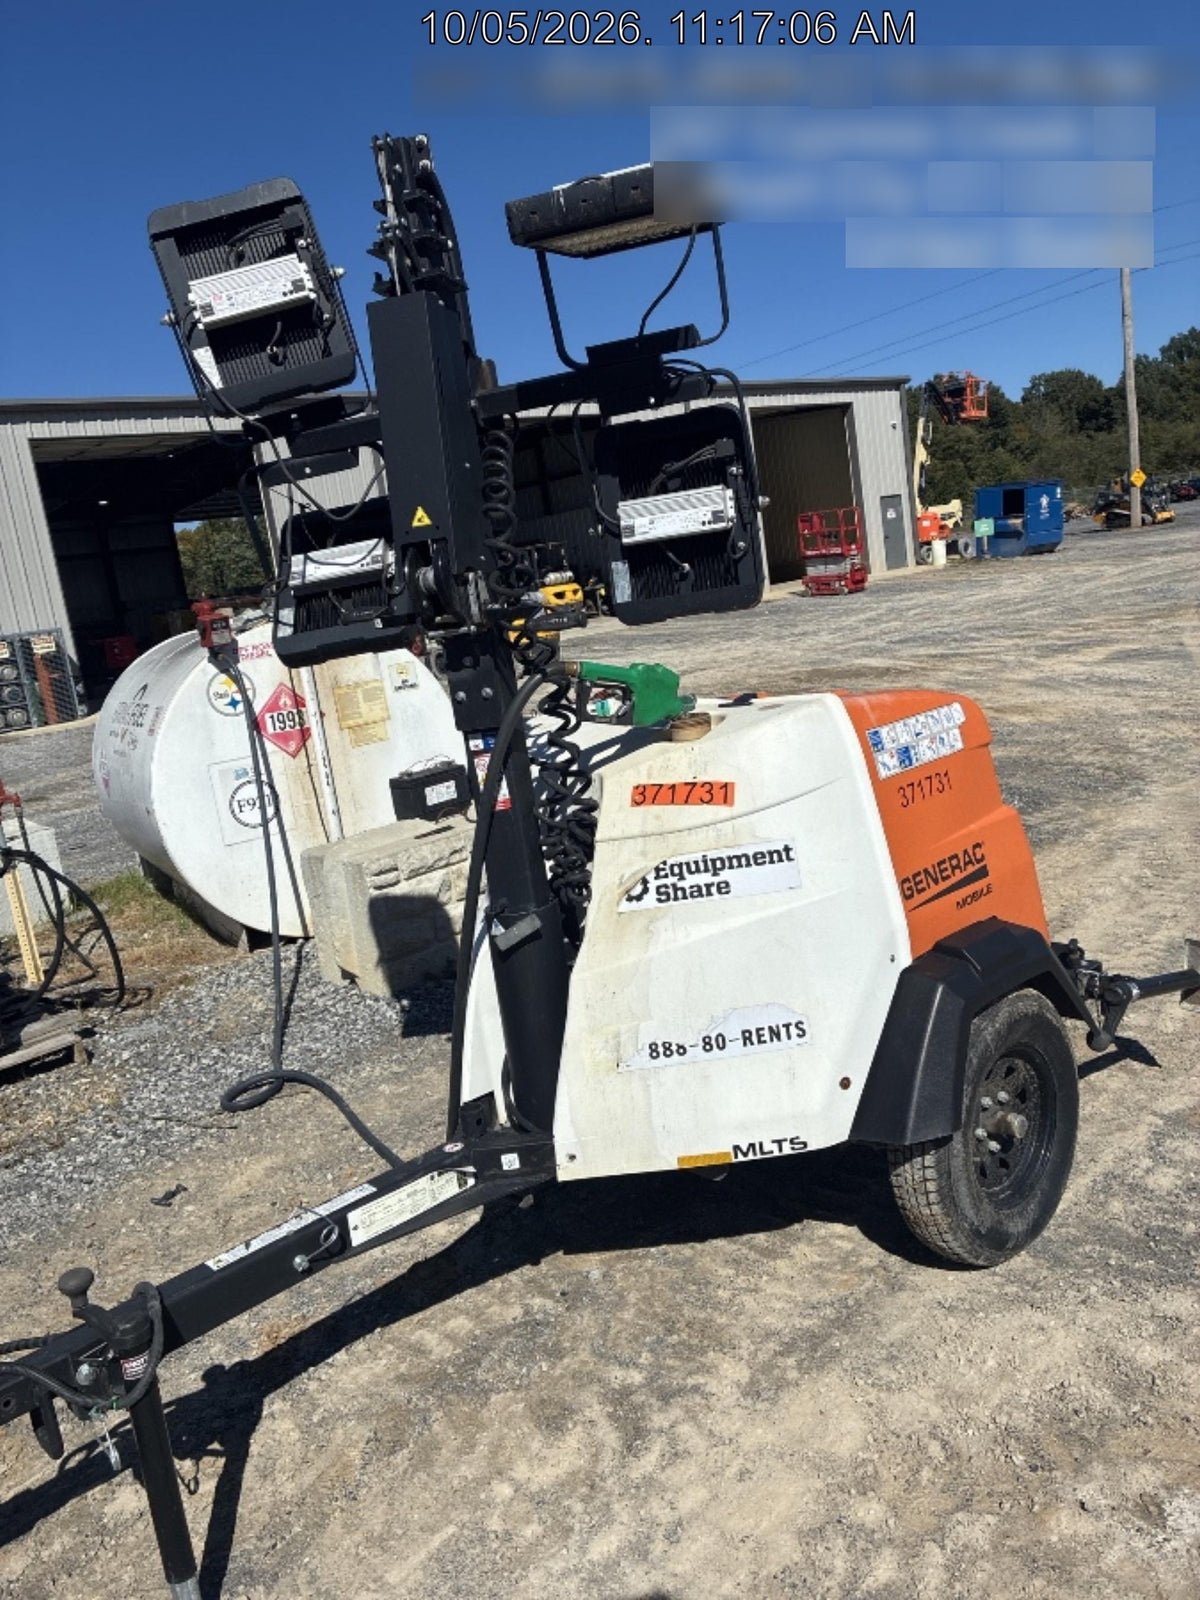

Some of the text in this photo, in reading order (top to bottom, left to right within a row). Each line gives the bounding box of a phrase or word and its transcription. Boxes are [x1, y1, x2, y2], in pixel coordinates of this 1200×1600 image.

[633, 781, 729, 806] 371731
[897, 769, 953, 808] 371731
[653, 844, 796, 882] Equipment
[900, 841, 986, 901] GENERAC
[655, 879, 732, 904] Share
[955, 882, 993, 911] MOBILE
[732, 1135, 808, 1160] MLTS
